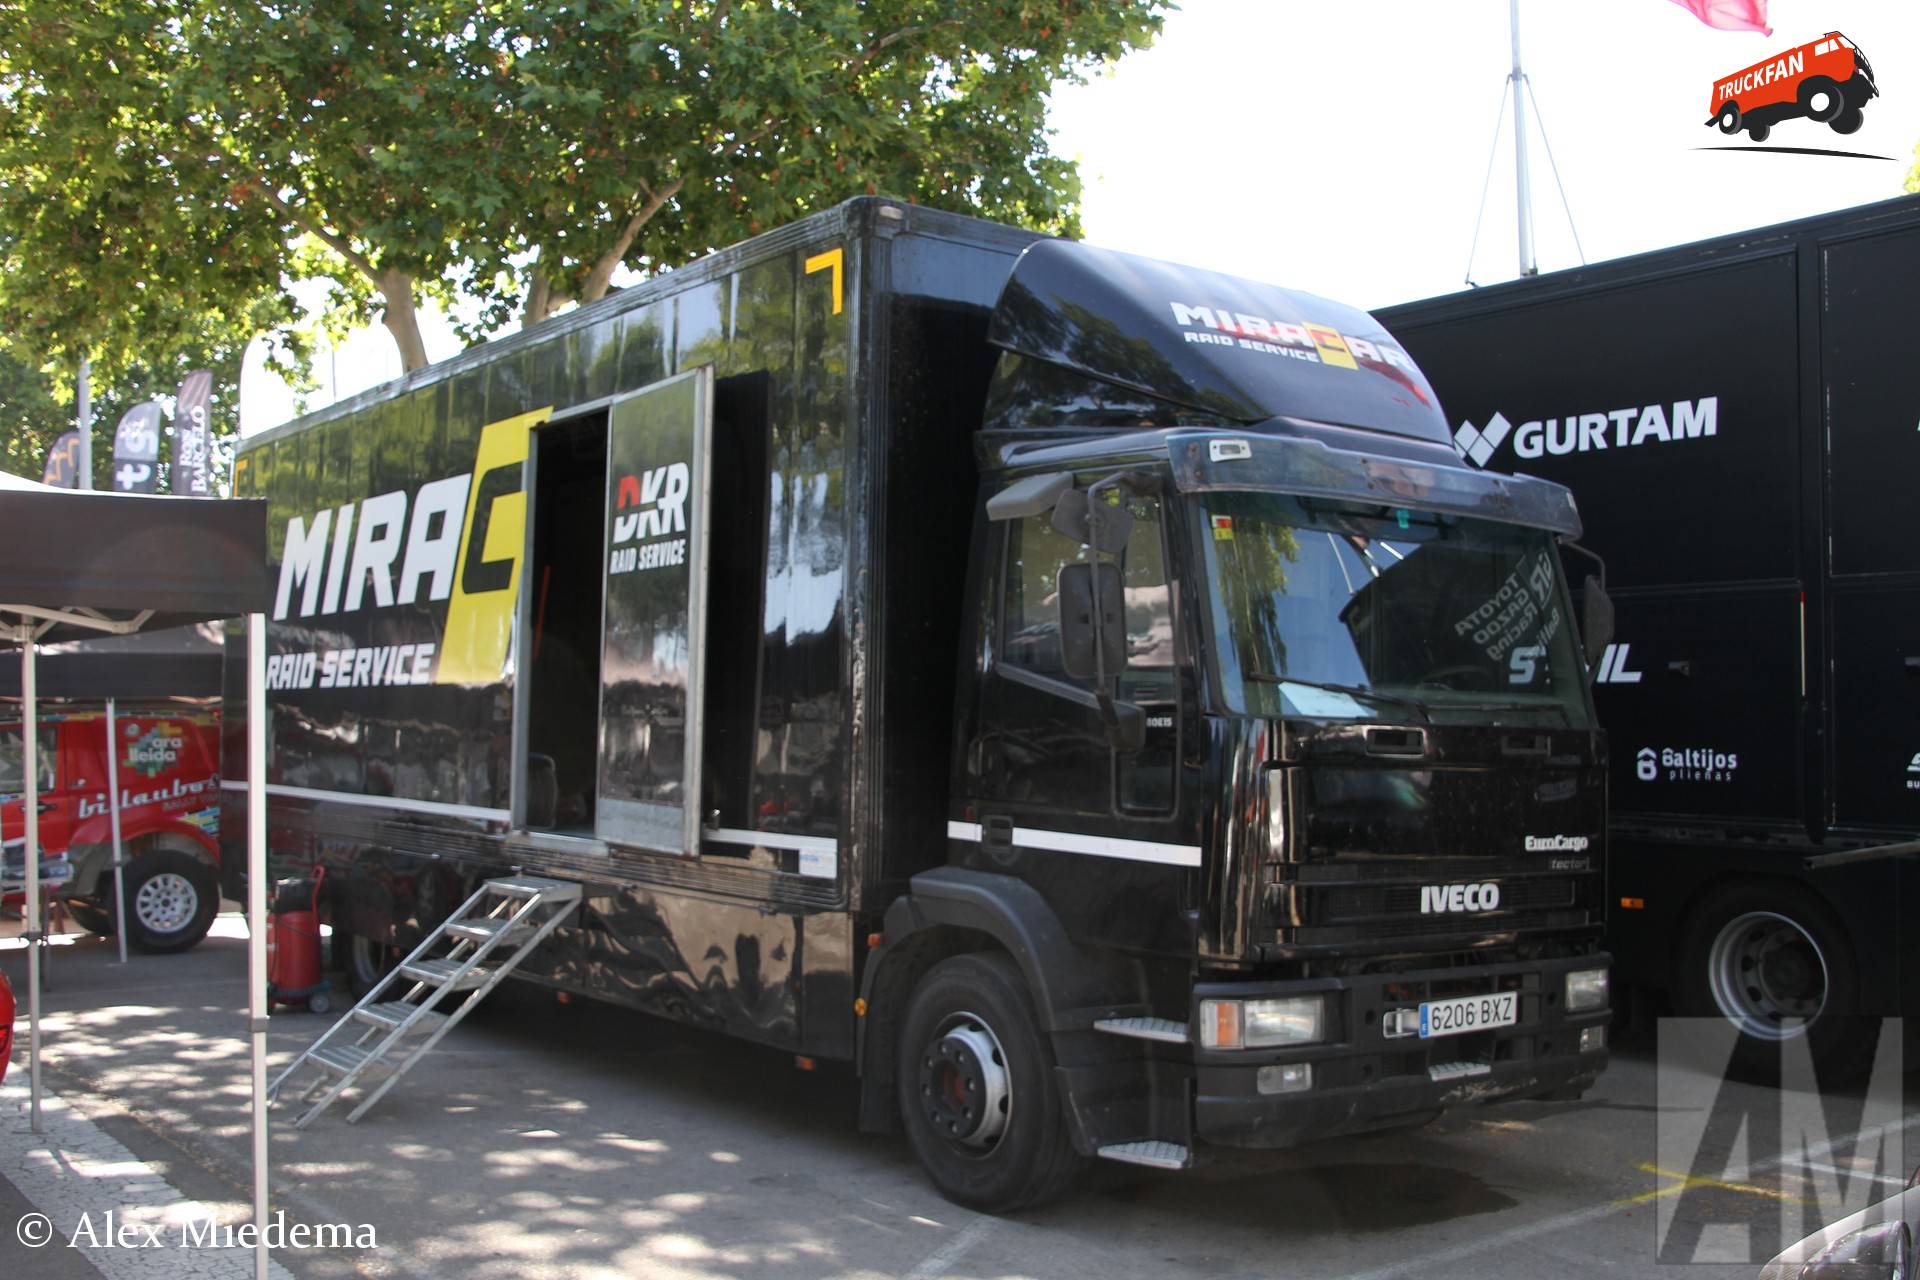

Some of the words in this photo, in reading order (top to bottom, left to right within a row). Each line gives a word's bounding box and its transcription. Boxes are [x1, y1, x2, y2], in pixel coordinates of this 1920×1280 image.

[1183, 331, 1234, 346] RAID
[1238, 337, 1321, 363] SERVICE
[1513, 396, 1718, 459] GURTAM
[609, 547, 638, 574] RAID
[638, 538, 686, 570] SERVICE
[265, 651, 317, 690] RAID
[319, 642, 436, 688] SERVICE
[1662, 747, 1737, 771] Baltijos
[1525, 834, 1588, 852] EuroCargo
[1420, 883, 1500, 914] IVECO
[1431, 1002, 1475, 1031] 6206
[1480, 997, 1512, 1024] BXZ
